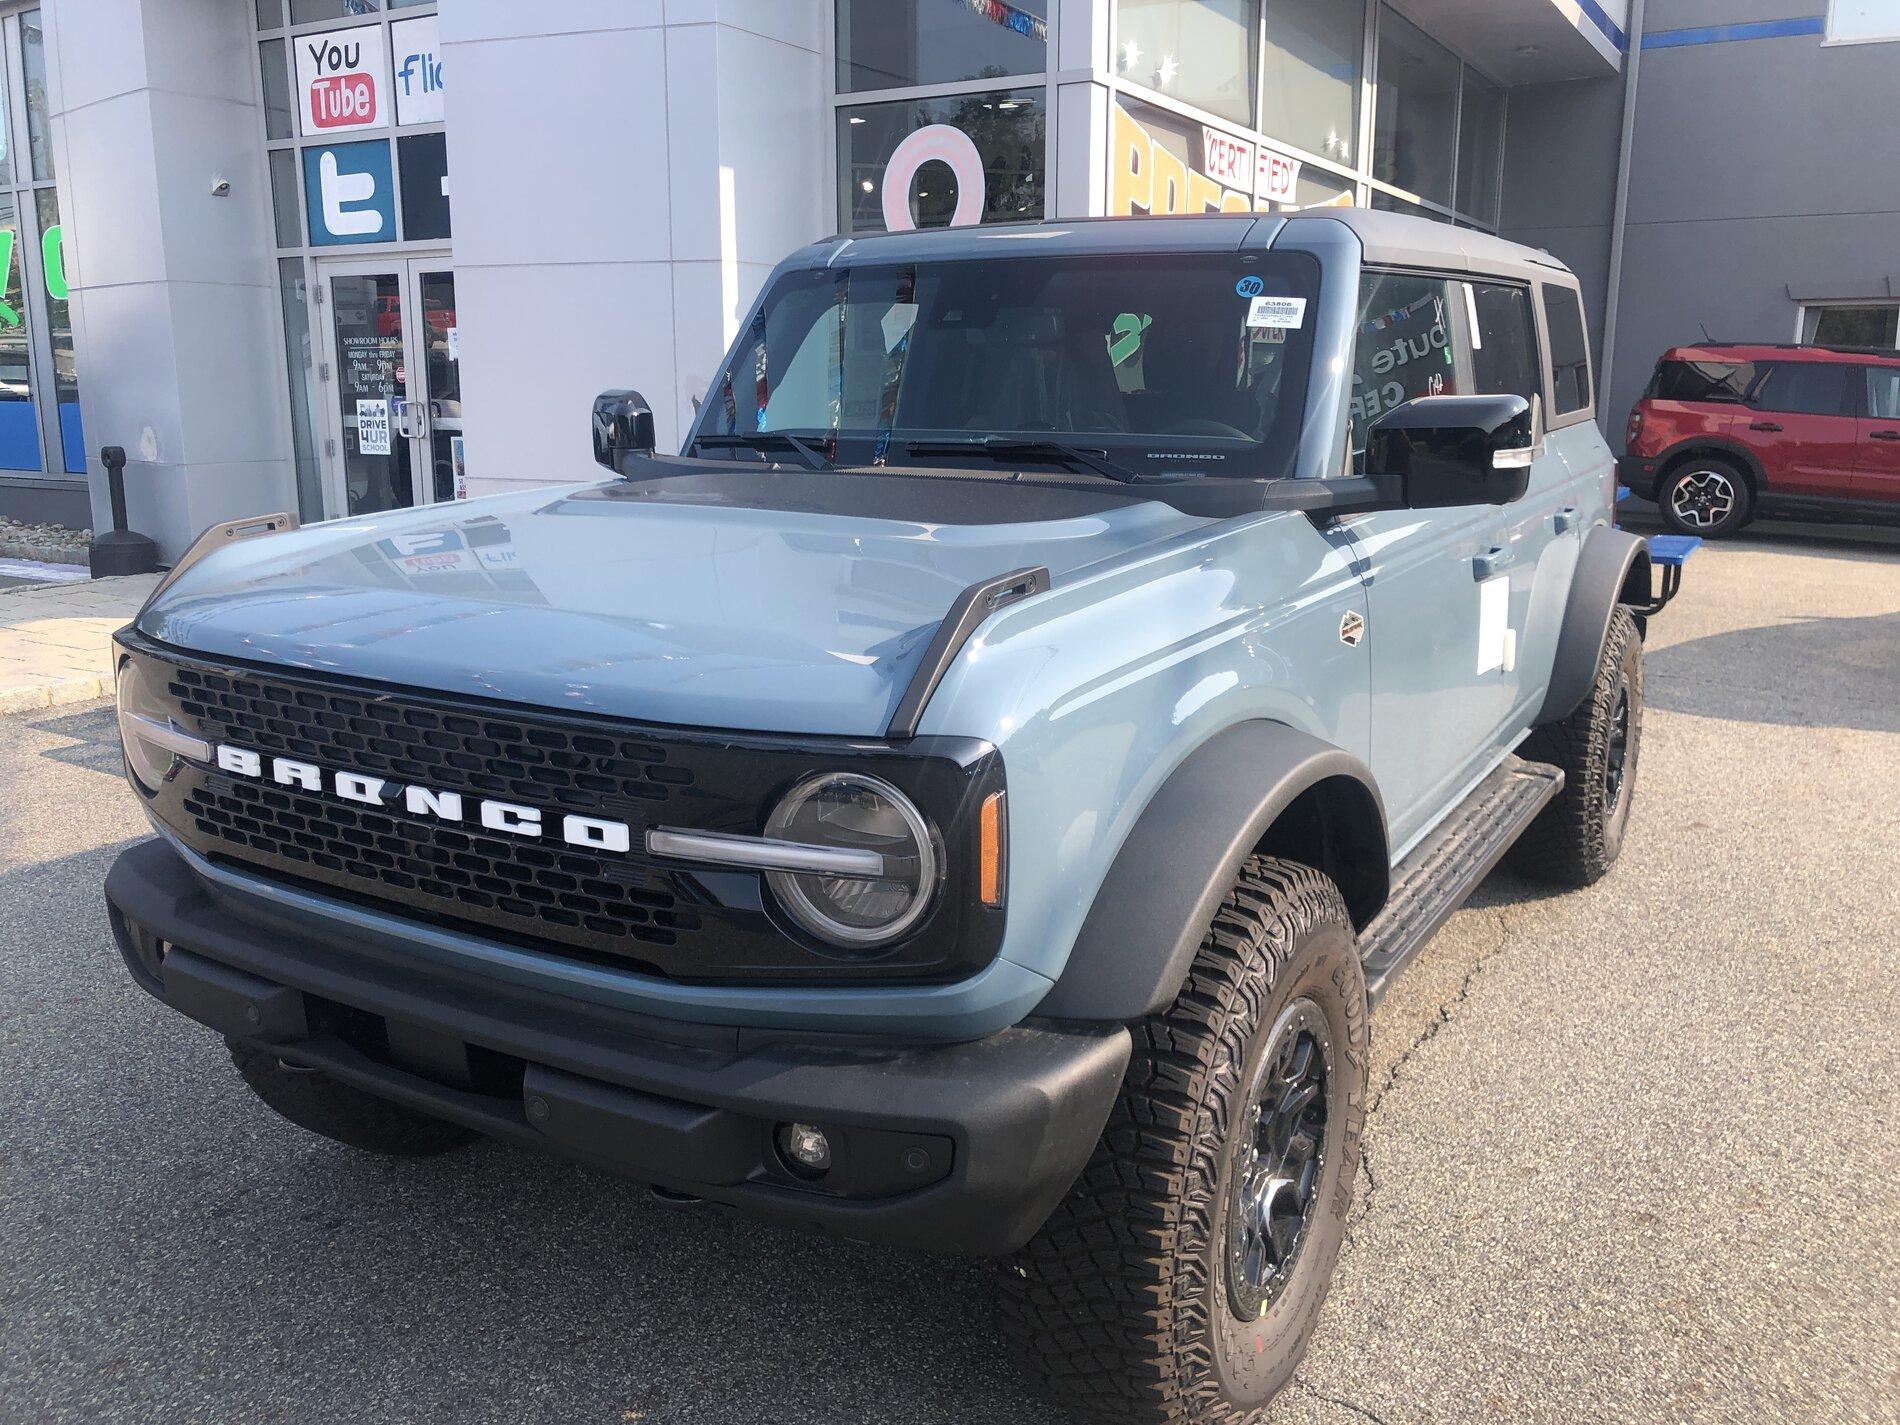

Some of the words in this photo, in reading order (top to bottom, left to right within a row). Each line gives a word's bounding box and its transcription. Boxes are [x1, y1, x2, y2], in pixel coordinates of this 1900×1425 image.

[308, 39, 360, 75] You
[312, 77, 370, 120] Tube
[1240, 279, 1261, 295] 30
[343, 336, 378, 346] SHOWROOM
[379, 336, 399, 345] HOURS
[347, 350, 368, 359] MONDAY
[379, 350, 395, 358] FRIDAY
[361, 373, 386, 381] SATURDAY
[360, 420, 387, 429] DRIVE
[361, 430, 388, 444] 4UR
[362, 444, 389, 452] SCHOOL
[216, 744, 630, 853] BRONCO
